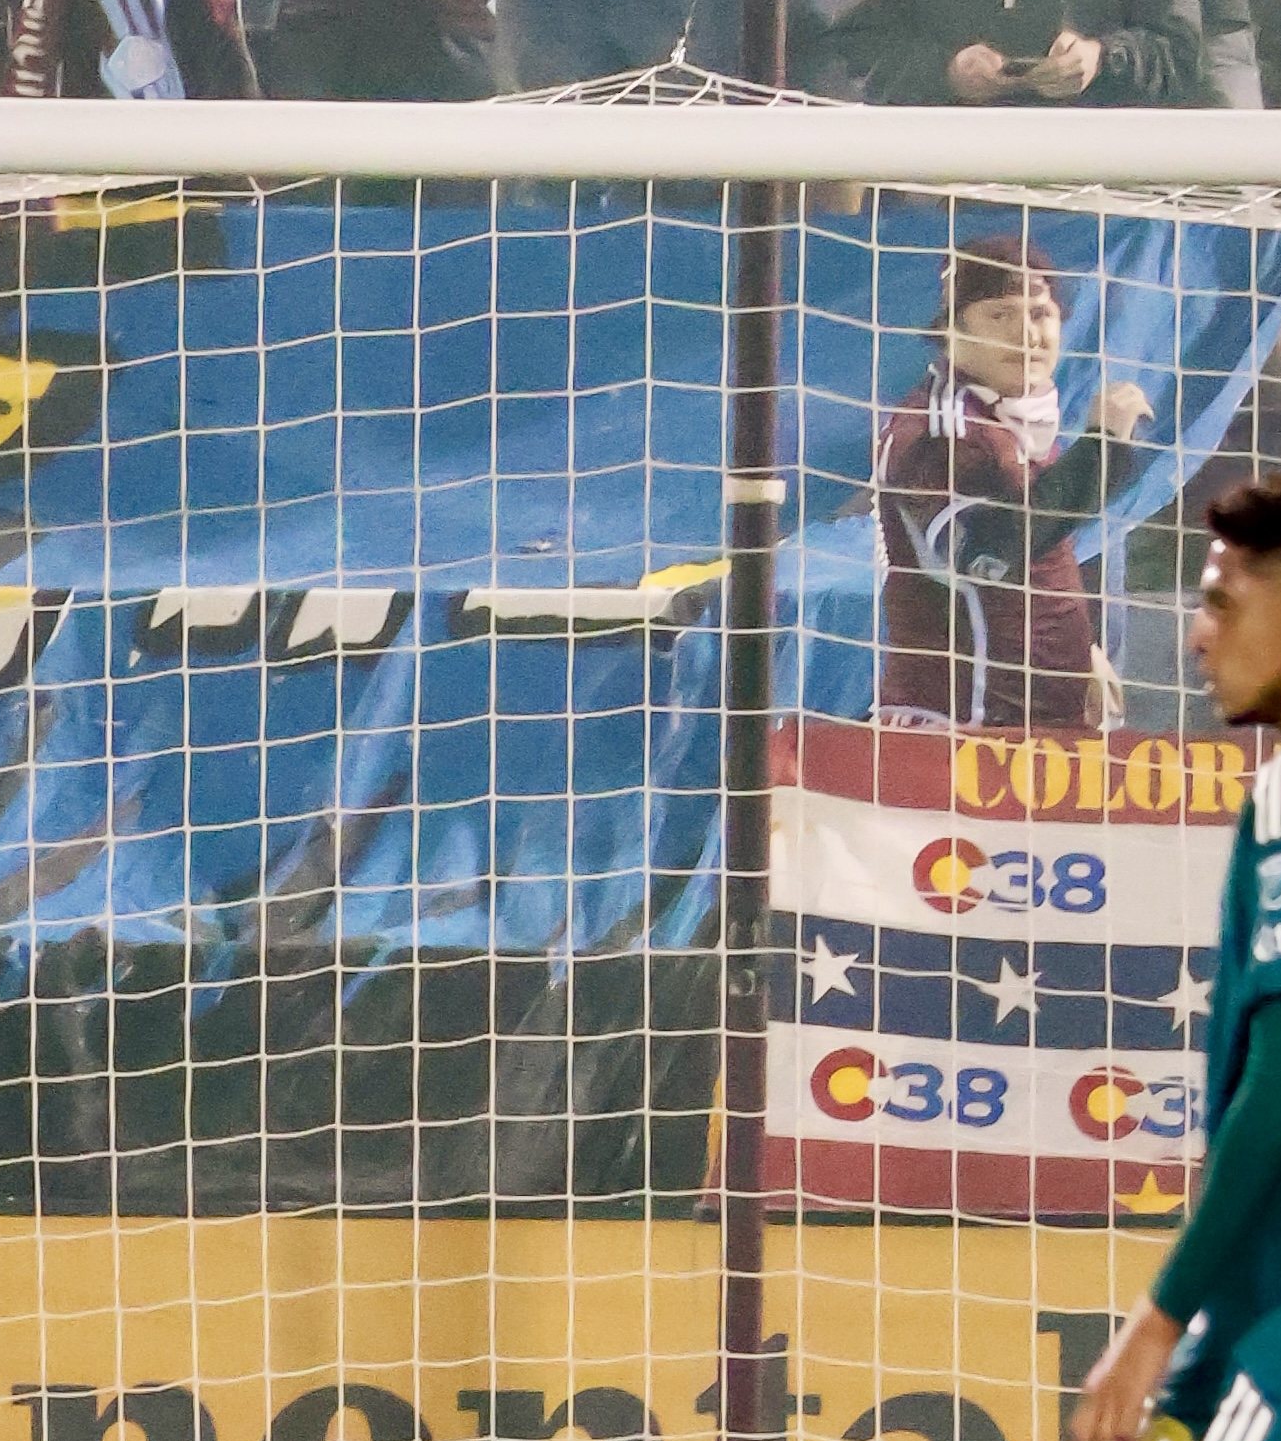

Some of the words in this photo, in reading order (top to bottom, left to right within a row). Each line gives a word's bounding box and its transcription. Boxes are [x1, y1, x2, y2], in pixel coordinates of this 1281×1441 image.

[912, 837, 1106, 914] C38
[810, 1045, 1008, 1127] C38
[1068, 1064, 1201, 1141] C3
